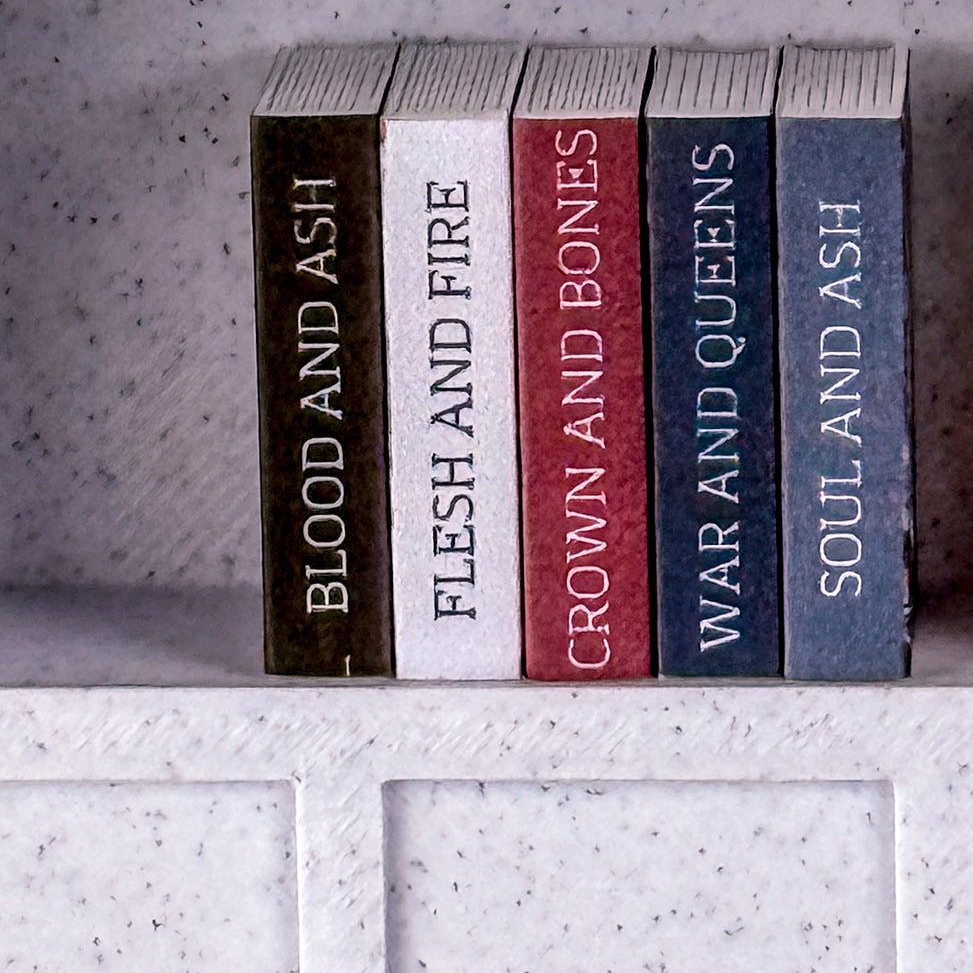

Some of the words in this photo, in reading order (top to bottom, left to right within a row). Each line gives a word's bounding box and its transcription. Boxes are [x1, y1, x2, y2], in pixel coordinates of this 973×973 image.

[293, 176, 339, 285] ASH
[426, 179, 473, 301] FIRE
[554, 128, 602, 311] BONES
[691, 143, 746, 369] QUEENS
[818, 198, 862, 310] ASH
[298, 300, 343, 421] AND
[430, 317, 475, 439] AND
[561, 328, 606, 449] AND
[820, 325, 862, 448] AND
[696, 387, 740, 505] AND
[301, 436, 349, 614] BLOOD
[431, 452, 477, 622] FLESH
[564, 467, 611, 670] CROWN
[818, 458, 863, 598] SOUL
[699, 521, 741, 653] WAR
